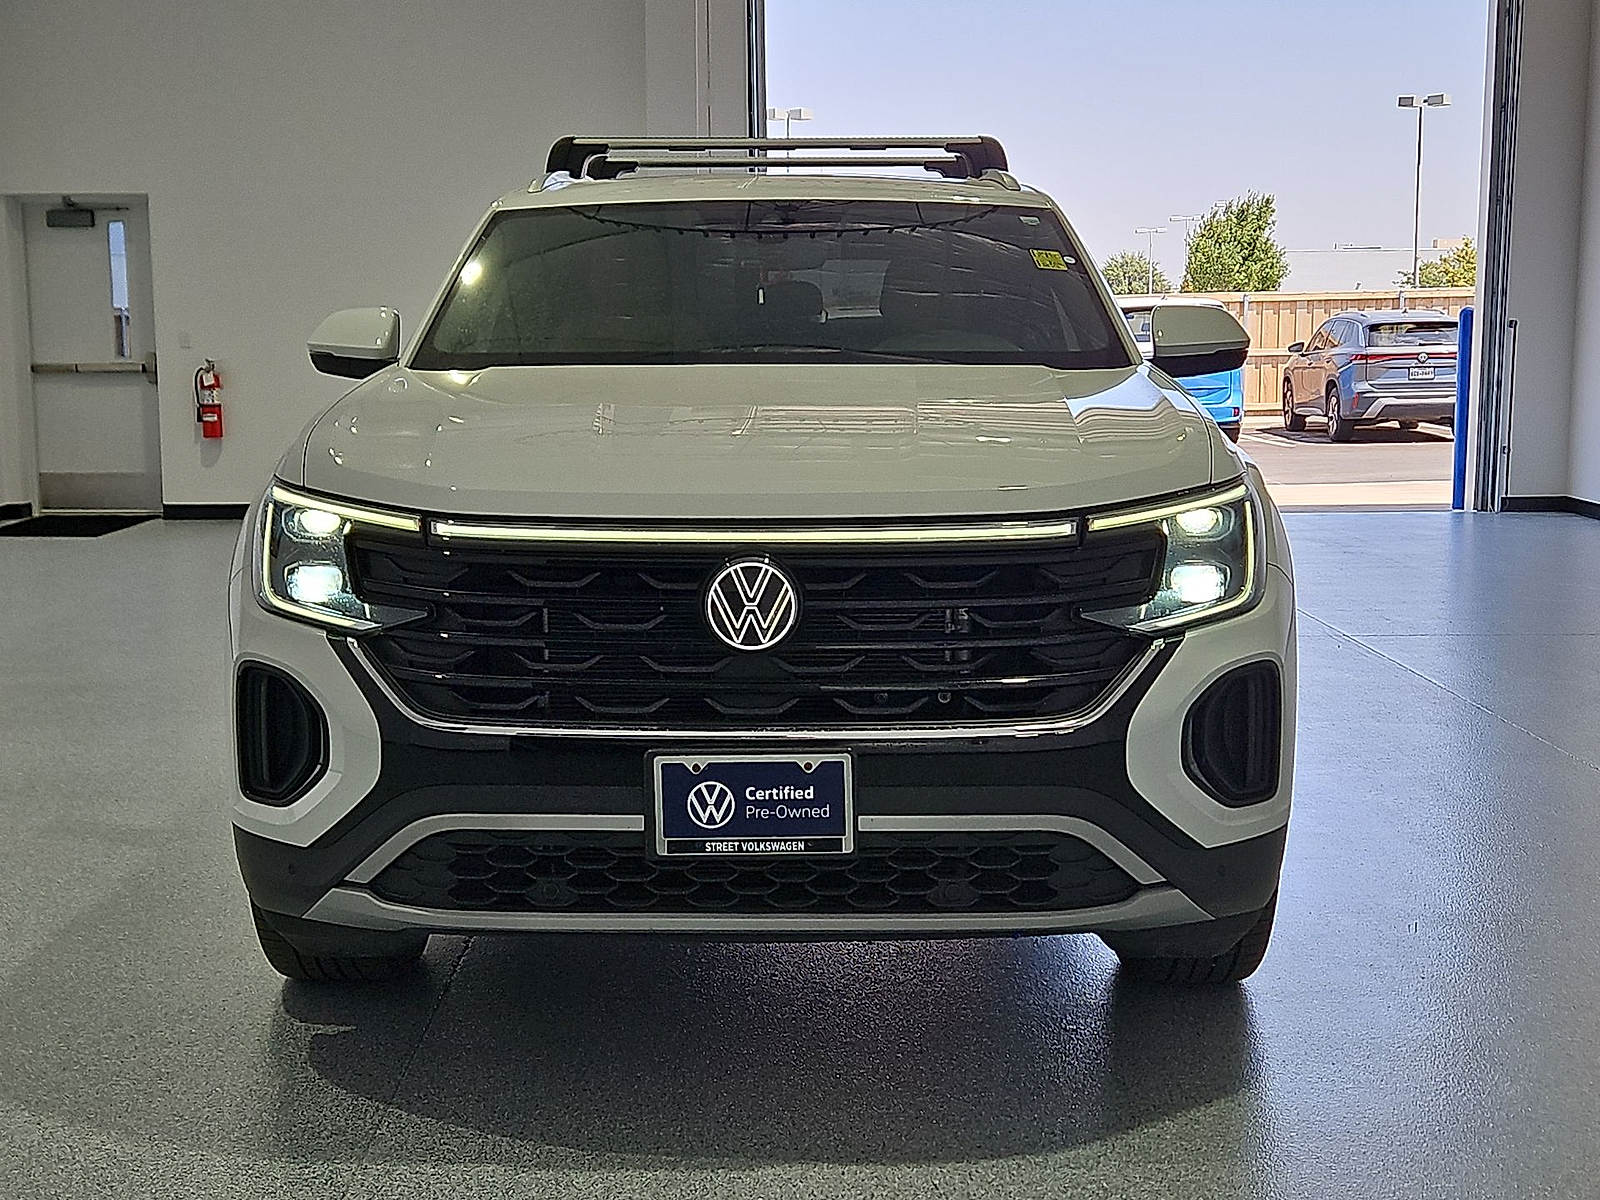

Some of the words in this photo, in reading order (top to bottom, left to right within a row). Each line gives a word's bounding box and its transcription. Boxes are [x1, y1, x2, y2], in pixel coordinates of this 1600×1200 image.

[709, 563, 795, 649] VW
[745, 785, 814, 801] Certified
[687, 781, 735, 828] VW
[745, 804, 830, 819] Pre-Owned
[705, 842, 739, 852] STREET
[741, 841, 805, 852] VOLKSWAGEN
